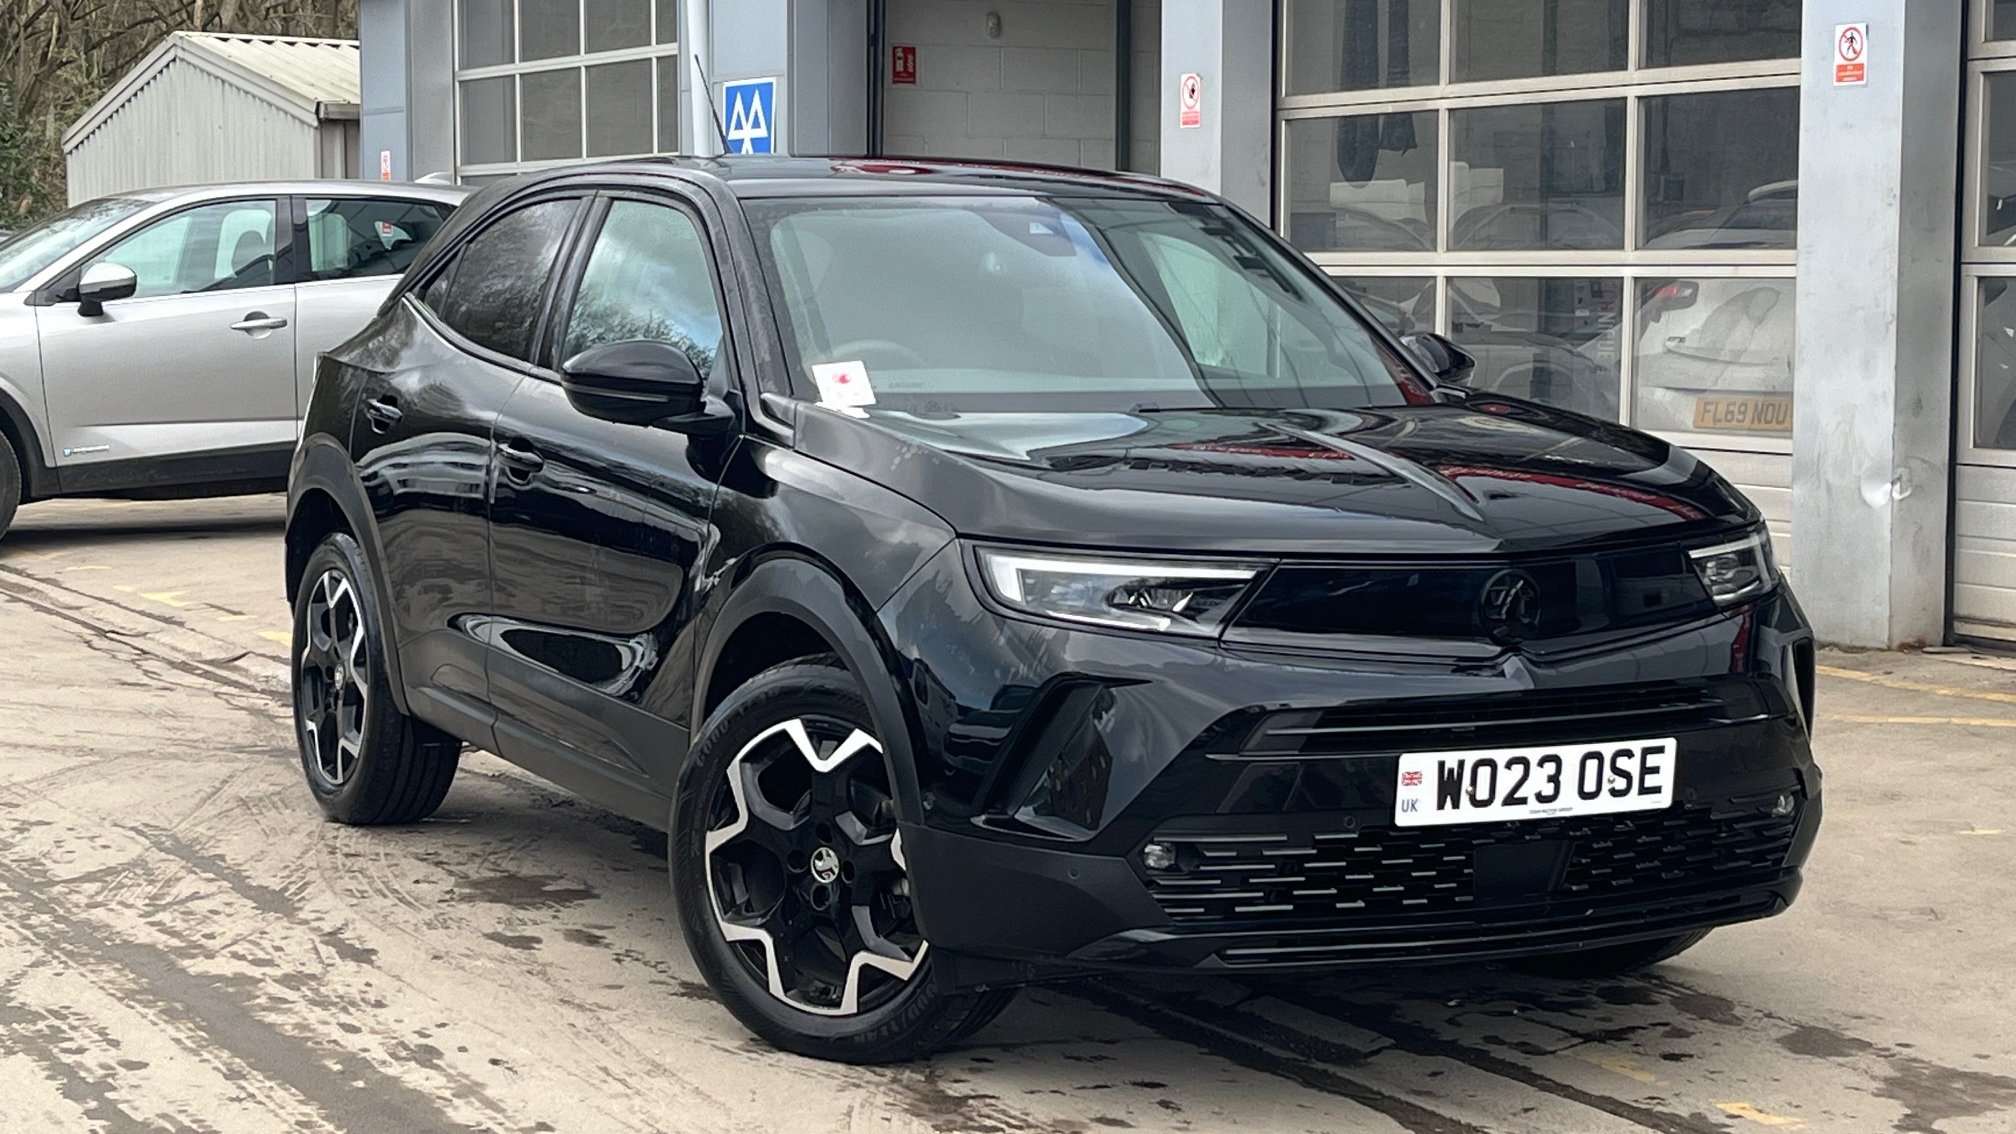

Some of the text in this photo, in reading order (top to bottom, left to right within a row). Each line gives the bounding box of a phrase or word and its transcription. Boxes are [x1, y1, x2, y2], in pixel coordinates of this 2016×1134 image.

[1700, 401, 1788, 425] FL69 NOU
[1436, 745, 1666, 810] WO23 OSE
[1401, 799, 1419, 813] UK
